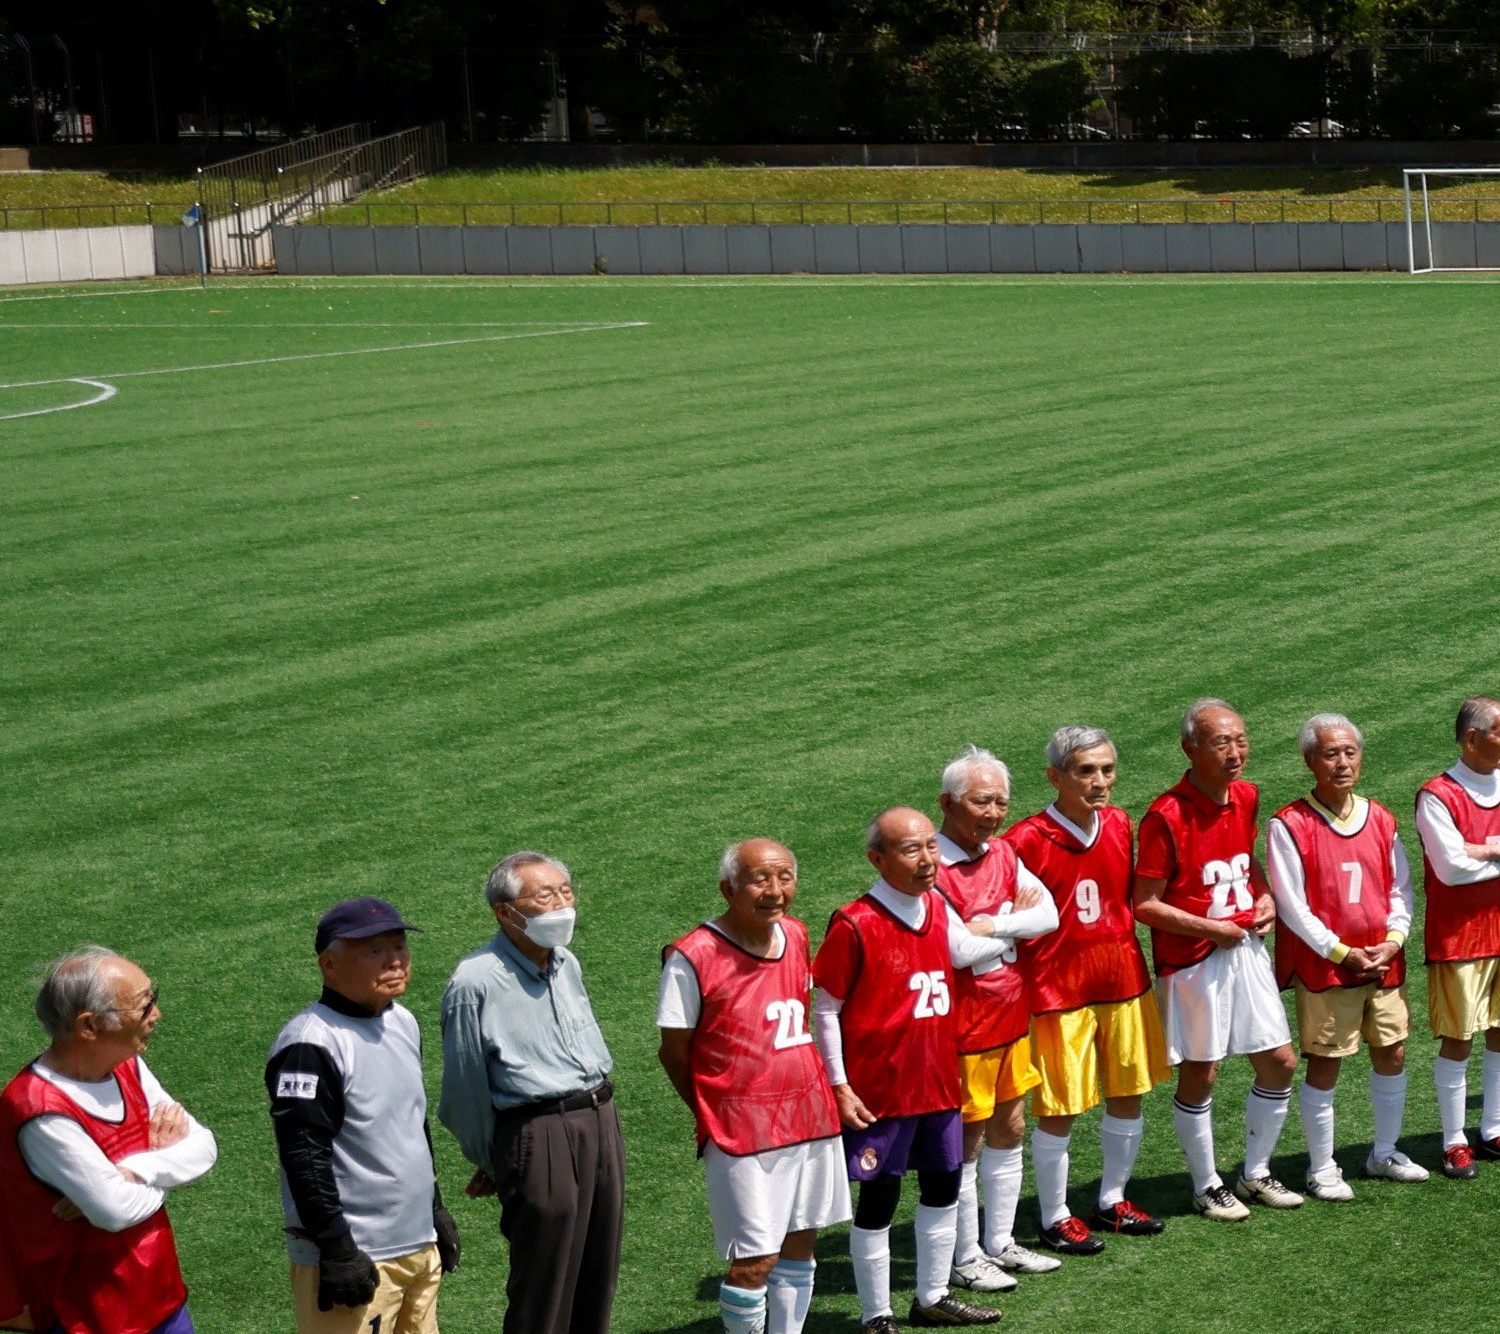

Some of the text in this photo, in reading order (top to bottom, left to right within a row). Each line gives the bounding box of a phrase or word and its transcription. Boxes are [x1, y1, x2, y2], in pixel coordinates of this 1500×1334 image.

[1076, 878, 1101, 924] 9
[1203, 853, 1254, 920] 26
[1341, 861, 1363, 904] 7
[909, 970, 950, 1020] 25
[766, 998, 814, 1050] 22
